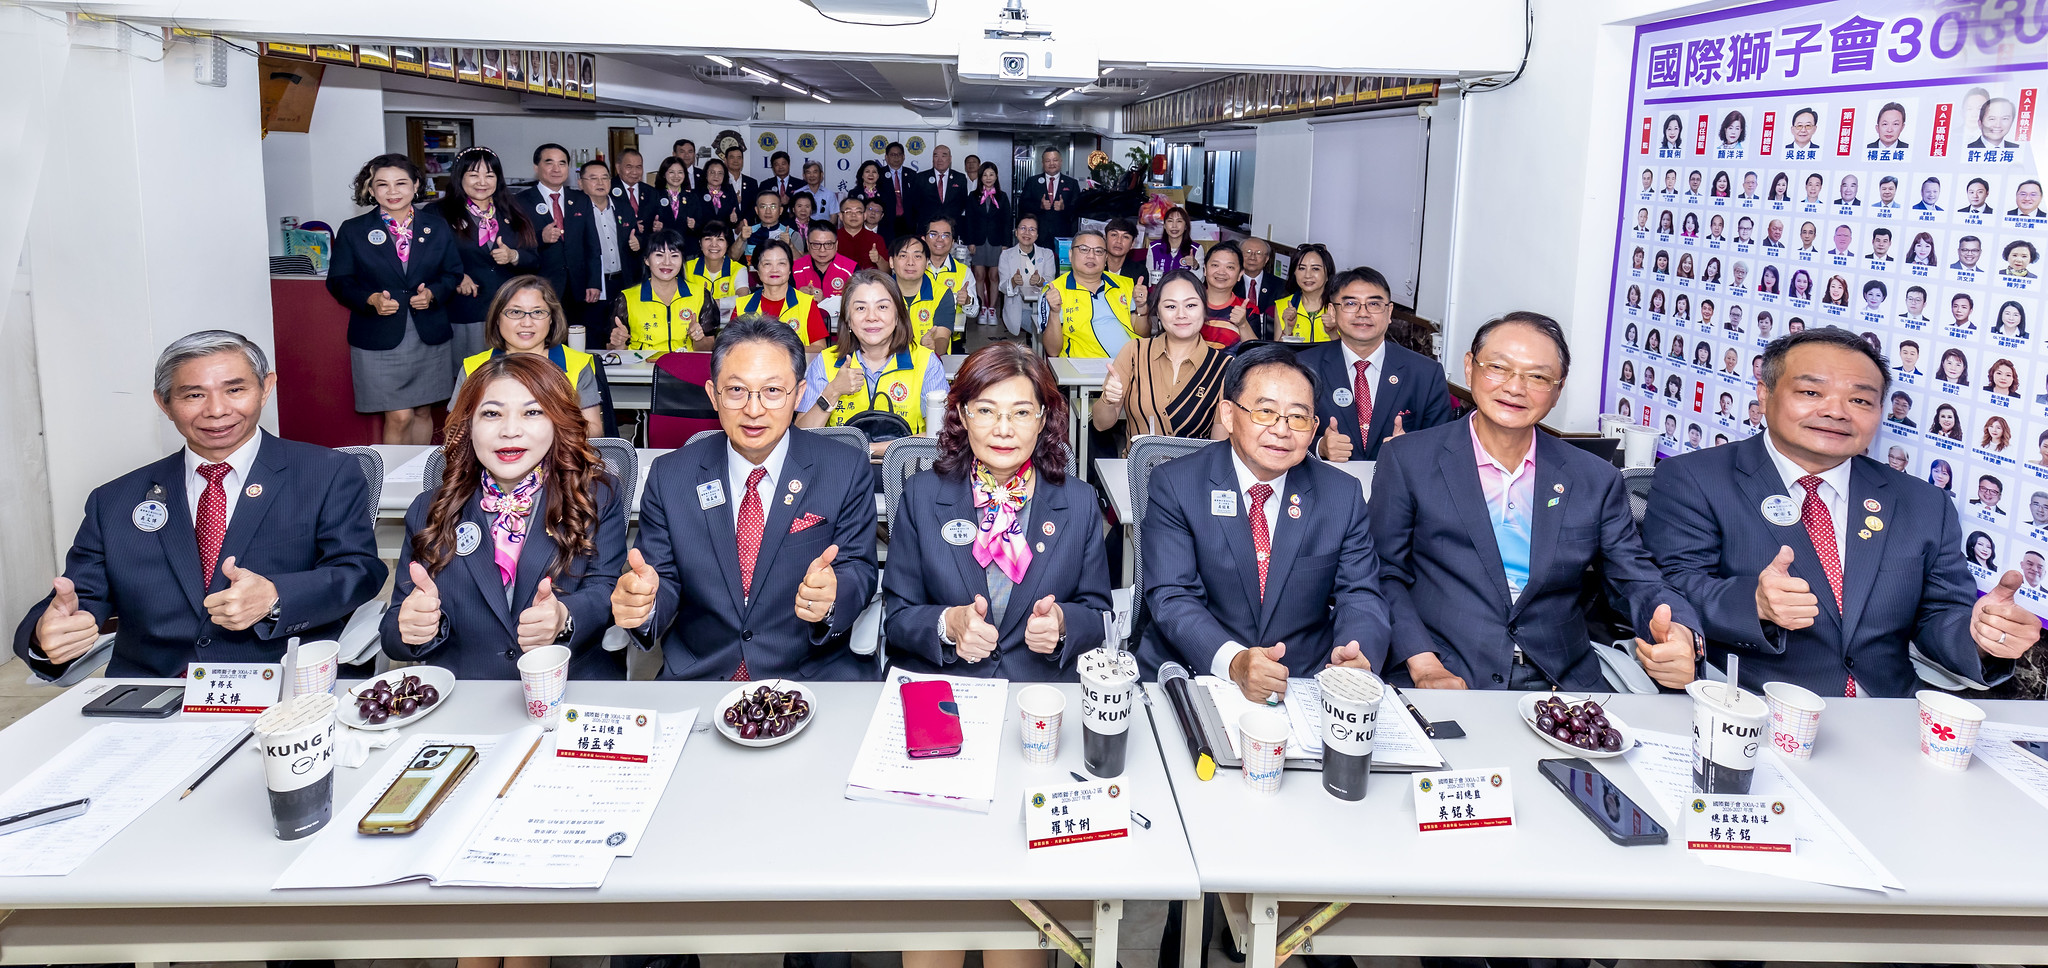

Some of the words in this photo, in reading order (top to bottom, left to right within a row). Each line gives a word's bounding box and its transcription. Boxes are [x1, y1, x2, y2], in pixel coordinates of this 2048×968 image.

[1762, 115, 1773, 153] 第一副總監
[1839, 112, 1853, 153] 第二副總監
[1933, 105, 1948, 157] GAT區執行長
[1786, 150, 1816, 160] 吳銘東
[1867, 150, 1904, 161] 楊孟峰
[1967, 150, 2014, 162] 許焜海
[837, 158, 850, 171] O
[210, 680, 233, 689] 事務長
[204, 692, 241, 705] 吳文博
[1104, 694, 1121, 704] FU
[1363, 710, 1377, 723] FU
[582, 723, 623, 735] 第二副總監
[267, 733, 322, 757] KUNG
[578, 737, 615, 751] 楊孟峰
[1439, 789, 1481, 801] 第一副總監
[1051, 805, 1069, 816] 總監
[1439, 804, 1476, 820] 吳銘東
[1711, 813, 1769, 825] 總監最高指導
[1051, 817, 1090, 836] 羅賢俐
[1710, 827, 1751, 841] 楊崇銘
